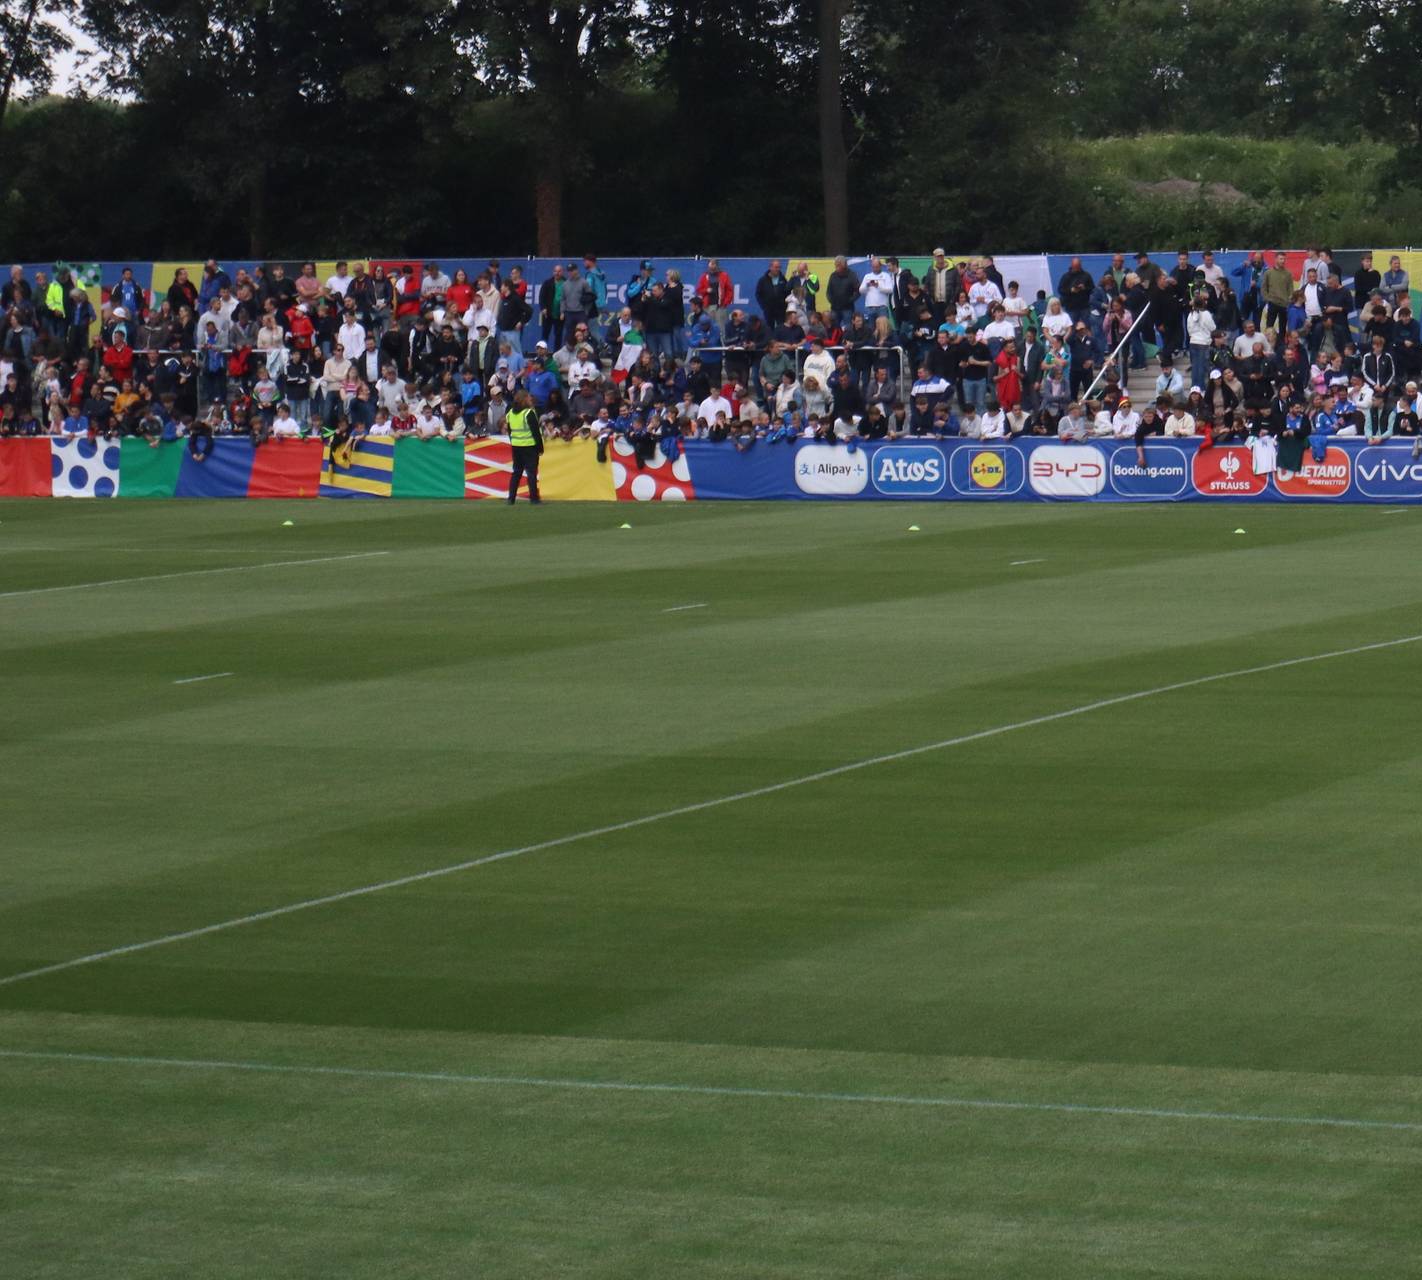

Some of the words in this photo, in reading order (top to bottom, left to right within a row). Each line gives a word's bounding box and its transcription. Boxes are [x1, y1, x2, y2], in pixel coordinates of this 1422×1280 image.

[817, 463, 851, 475] Alipay
[1033, 462, 1102, 477] BYD
[1114, 464, 1183, 478] Booking.com
[1210, 482, 1250, 490] STRAUSS
